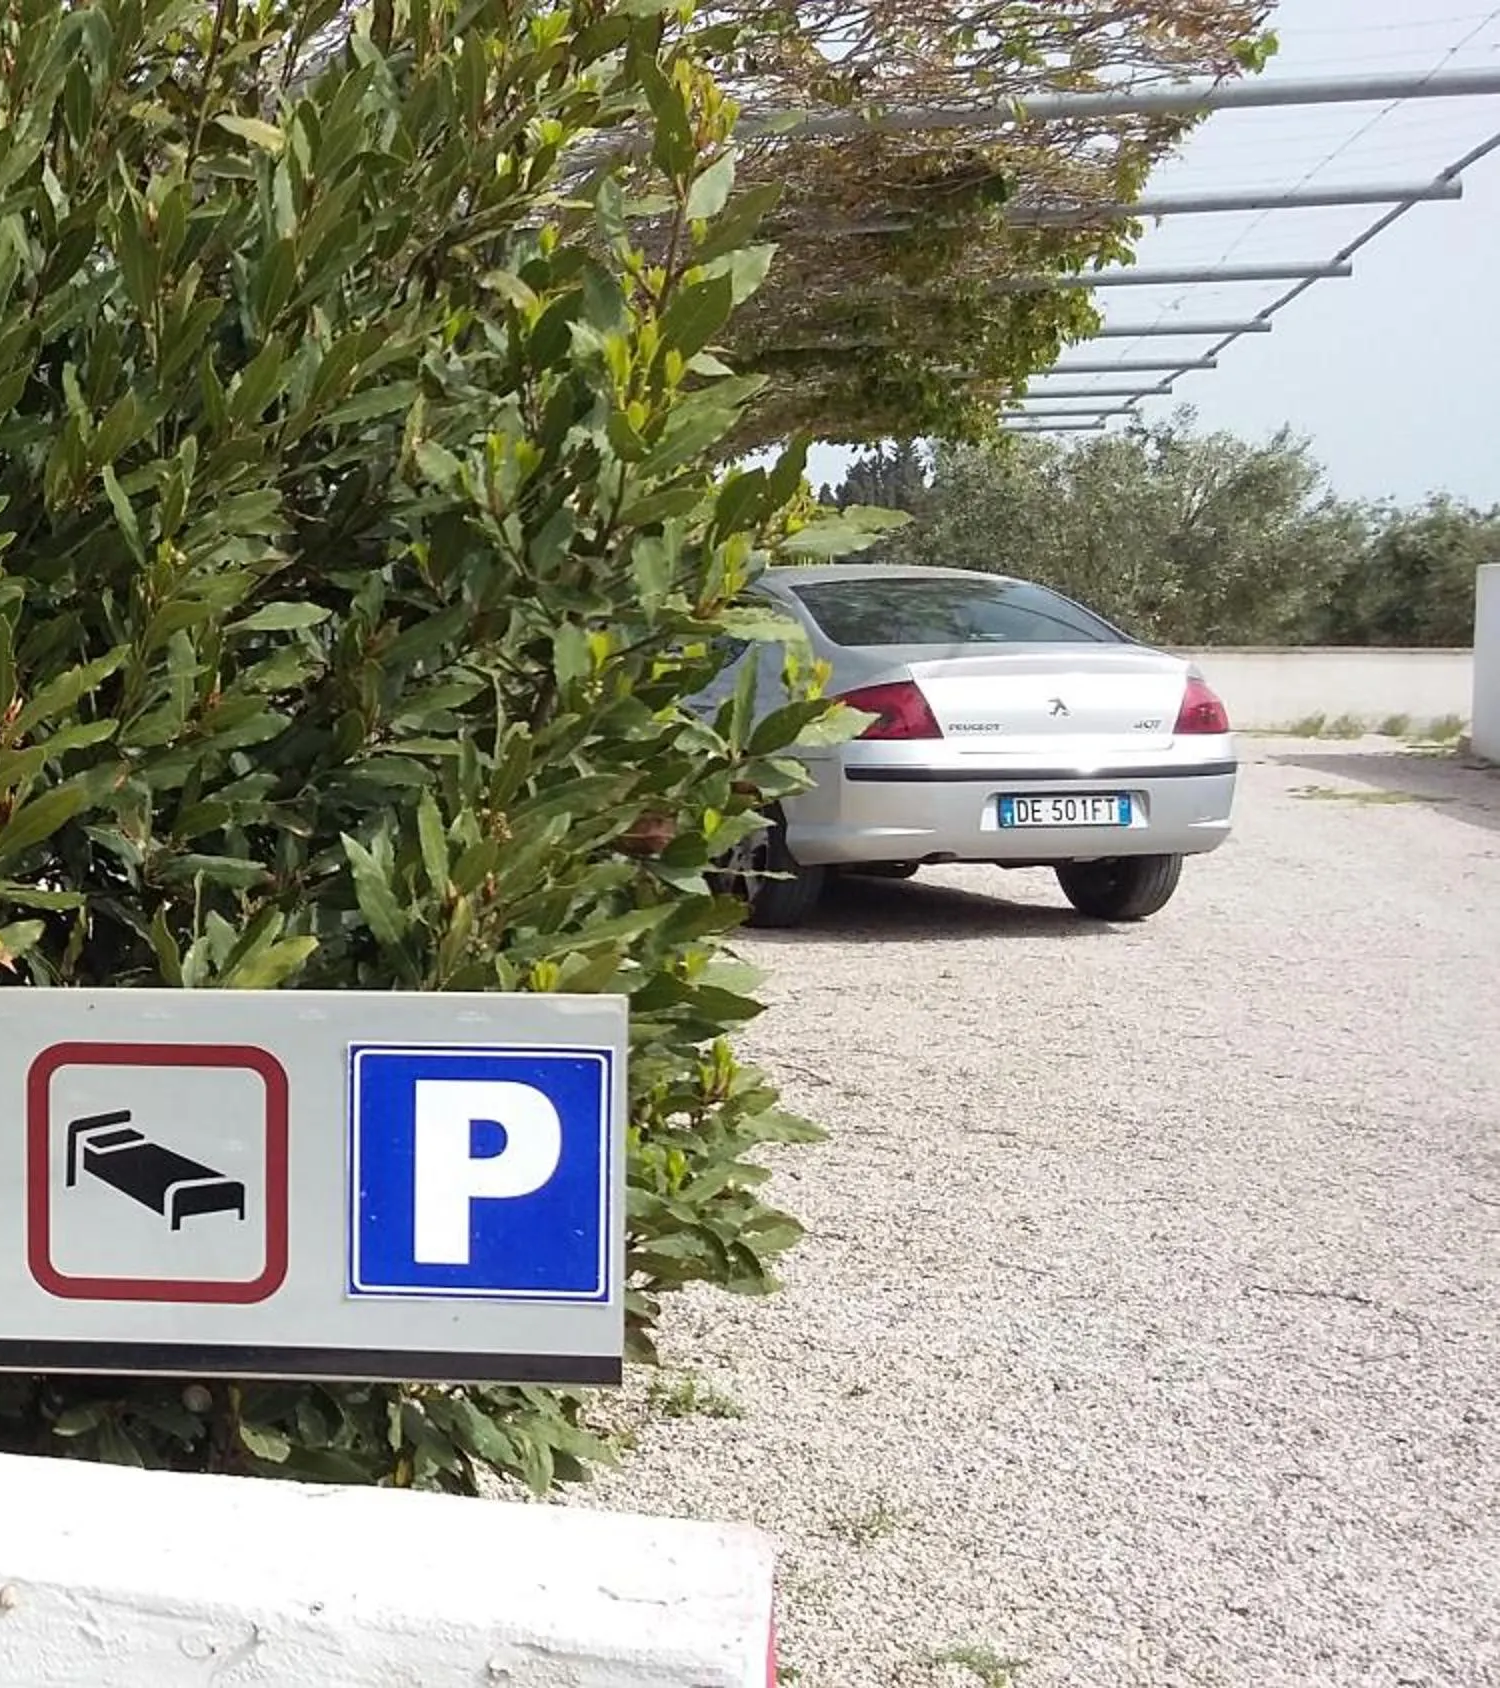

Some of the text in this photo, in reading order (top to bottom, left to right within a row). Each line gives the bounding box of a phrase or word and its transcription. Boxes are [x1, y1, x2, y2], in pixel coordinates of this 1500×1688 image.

[948, 722, 1003, 732] PEUGEOT
[1016, 799, 1042, 822] DE
[413, 1079, 562, 1265] P
